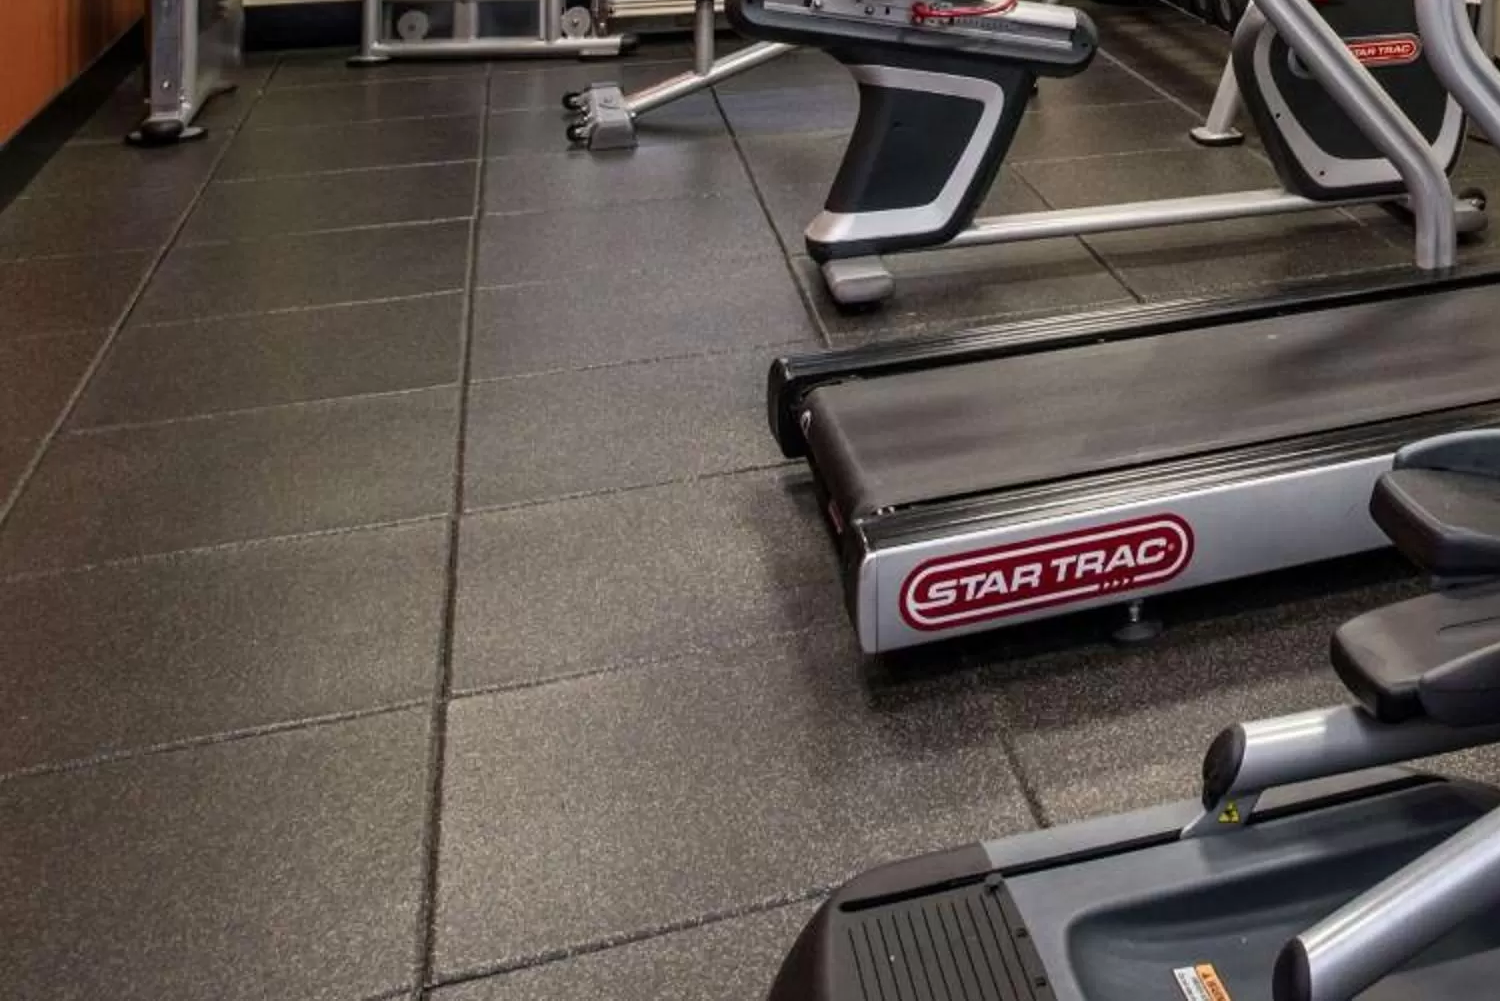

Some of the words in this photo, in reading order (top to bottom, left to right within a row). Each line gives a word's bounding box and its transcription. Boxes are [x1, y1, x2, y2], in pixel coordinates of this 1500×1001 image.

[1353, 47, 1377, 57] TAR
[924, 562, 1043, 607] STAR
[1050, 537, 1168, 582] TRAC
